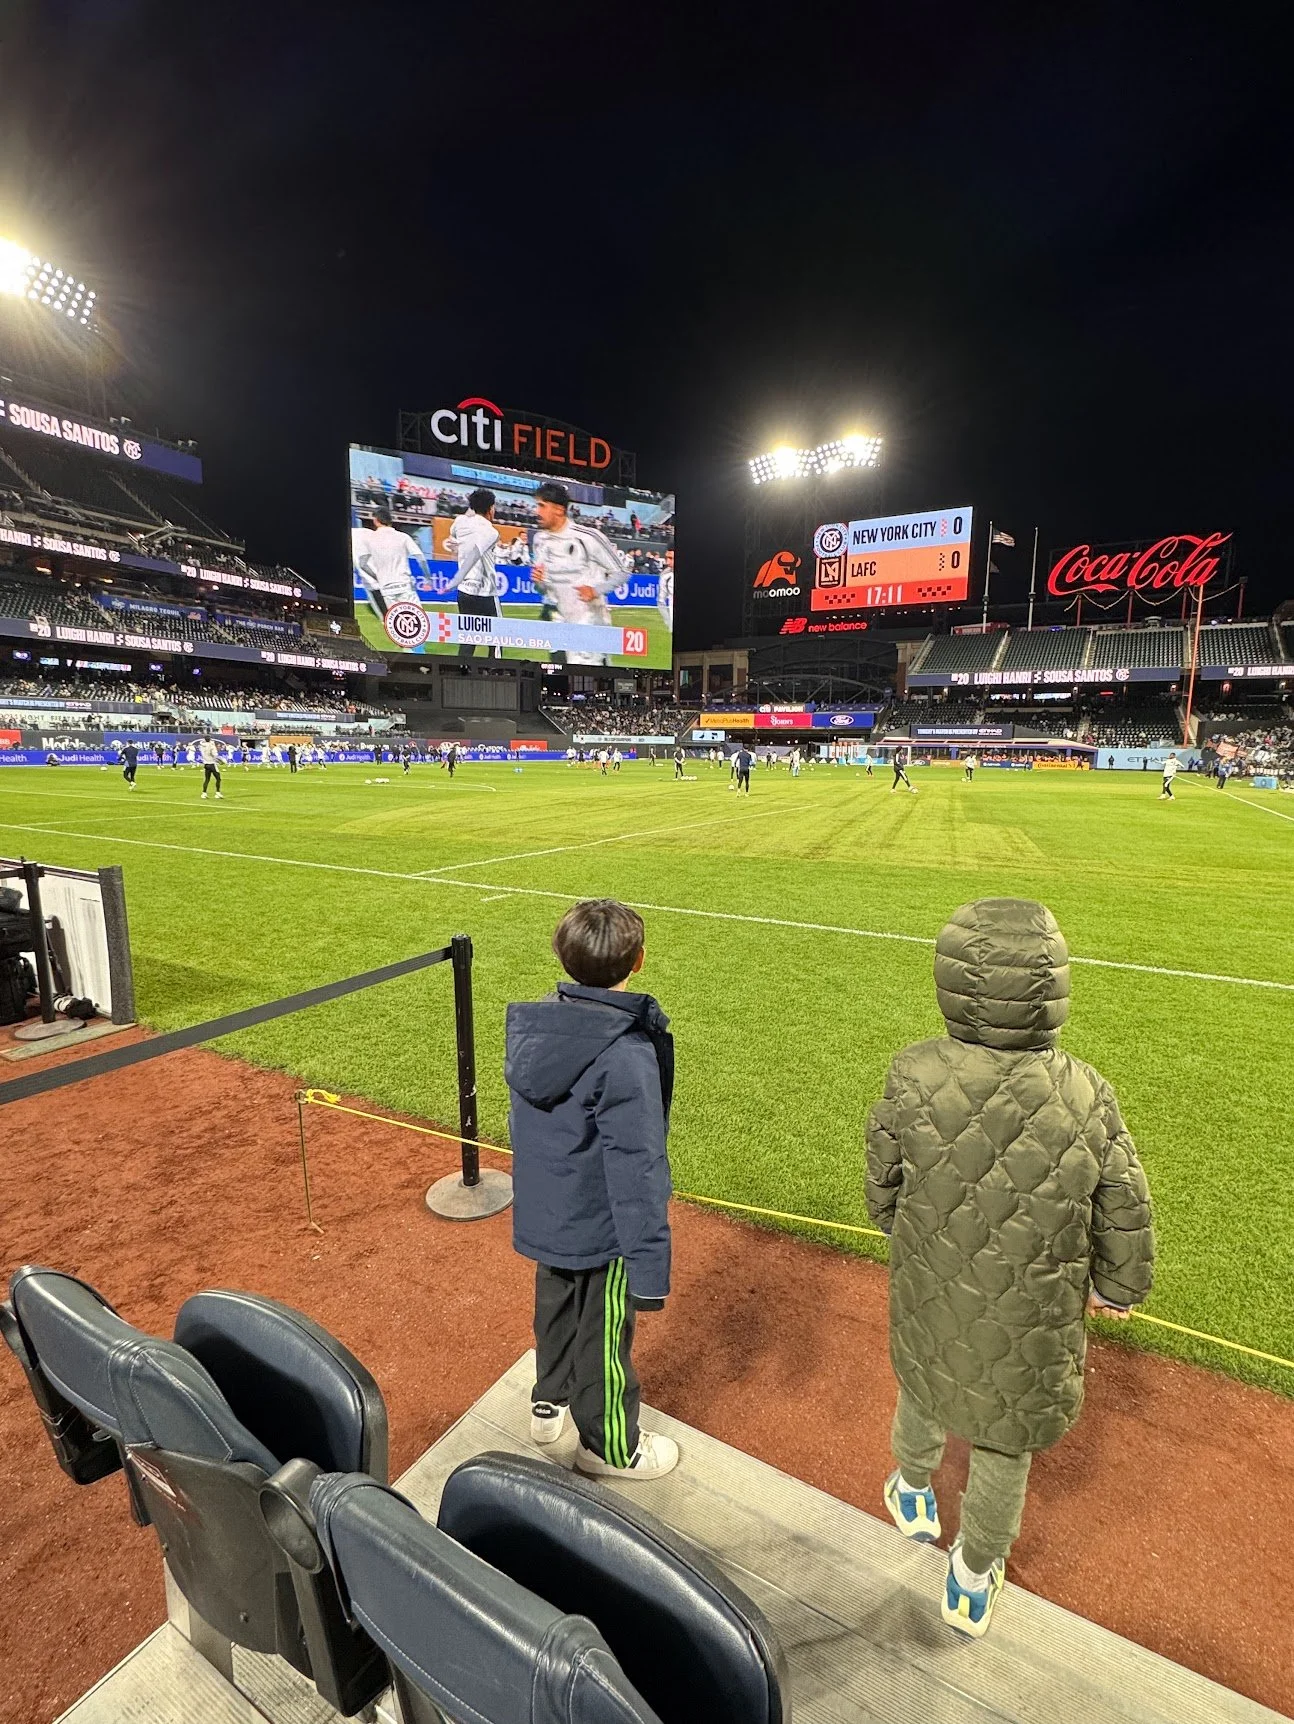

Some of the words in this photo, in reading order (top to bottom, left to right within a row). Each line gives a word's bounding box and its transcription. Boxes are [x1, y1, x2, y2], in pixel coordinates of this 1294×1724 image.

[8, 403, 62, 438] SOUSA
[61, 419, 120, 455] SANTOS
[431, 406, 502, 452] citi
[513, 423, 612, 469] FIELD
[853, 528, 878, 545] NEW
[881, 525, 909, 542] YORK
[911, 521, 937, 538] CITY
[953, 516, 963, 535] 0
[0, 529, 31, 546] HANRI
[43, 537, 73, 555] SOUSA
[72, 543, 108, 561] SANTOS
[851, 561, 877, 577] LAFC
[951, 551, 960, 569] 0
[1048, 532, 1233, 596] Coca-Cola
[249, 579, 270, 592] SOUSA
[269, 583, 294, 597] SANTOS
[630, 583, 655, 598] Judi
[753, 587, 800, 598] moomoo
[867, 584, 902, 605] 17:11
[130, 604, 158, 615] MILAGRO
[389, 608, 399, 620] NEW
[458, 616, 492, 633] LUIGHI
[808, 624, 827, 632] new
[828, 621, 867, 632] balance
[56, 626, 87, 641] LUIGHI
[87, 630, 114, 645] HANRI
[125, 634, 151, 649] SOUSA
[151, 638, 182, 653] SANTOS
[484, 636, 527, 648] PAULO,
[529, 638, 552, 649] BRA
[626, 630, 644, 653] 20
[974, 672, 1003, 685] LUIGHI
[1003, 671, 1032, 684] HANRI
[1043, 670, 1073, 683] SOUSA
[1074, 669, 1114, 682] SANTOS
[0, 754, 27, 762] Health
[60, 754, 78, 763] Judi
[79, 754, 104, 762] Health
